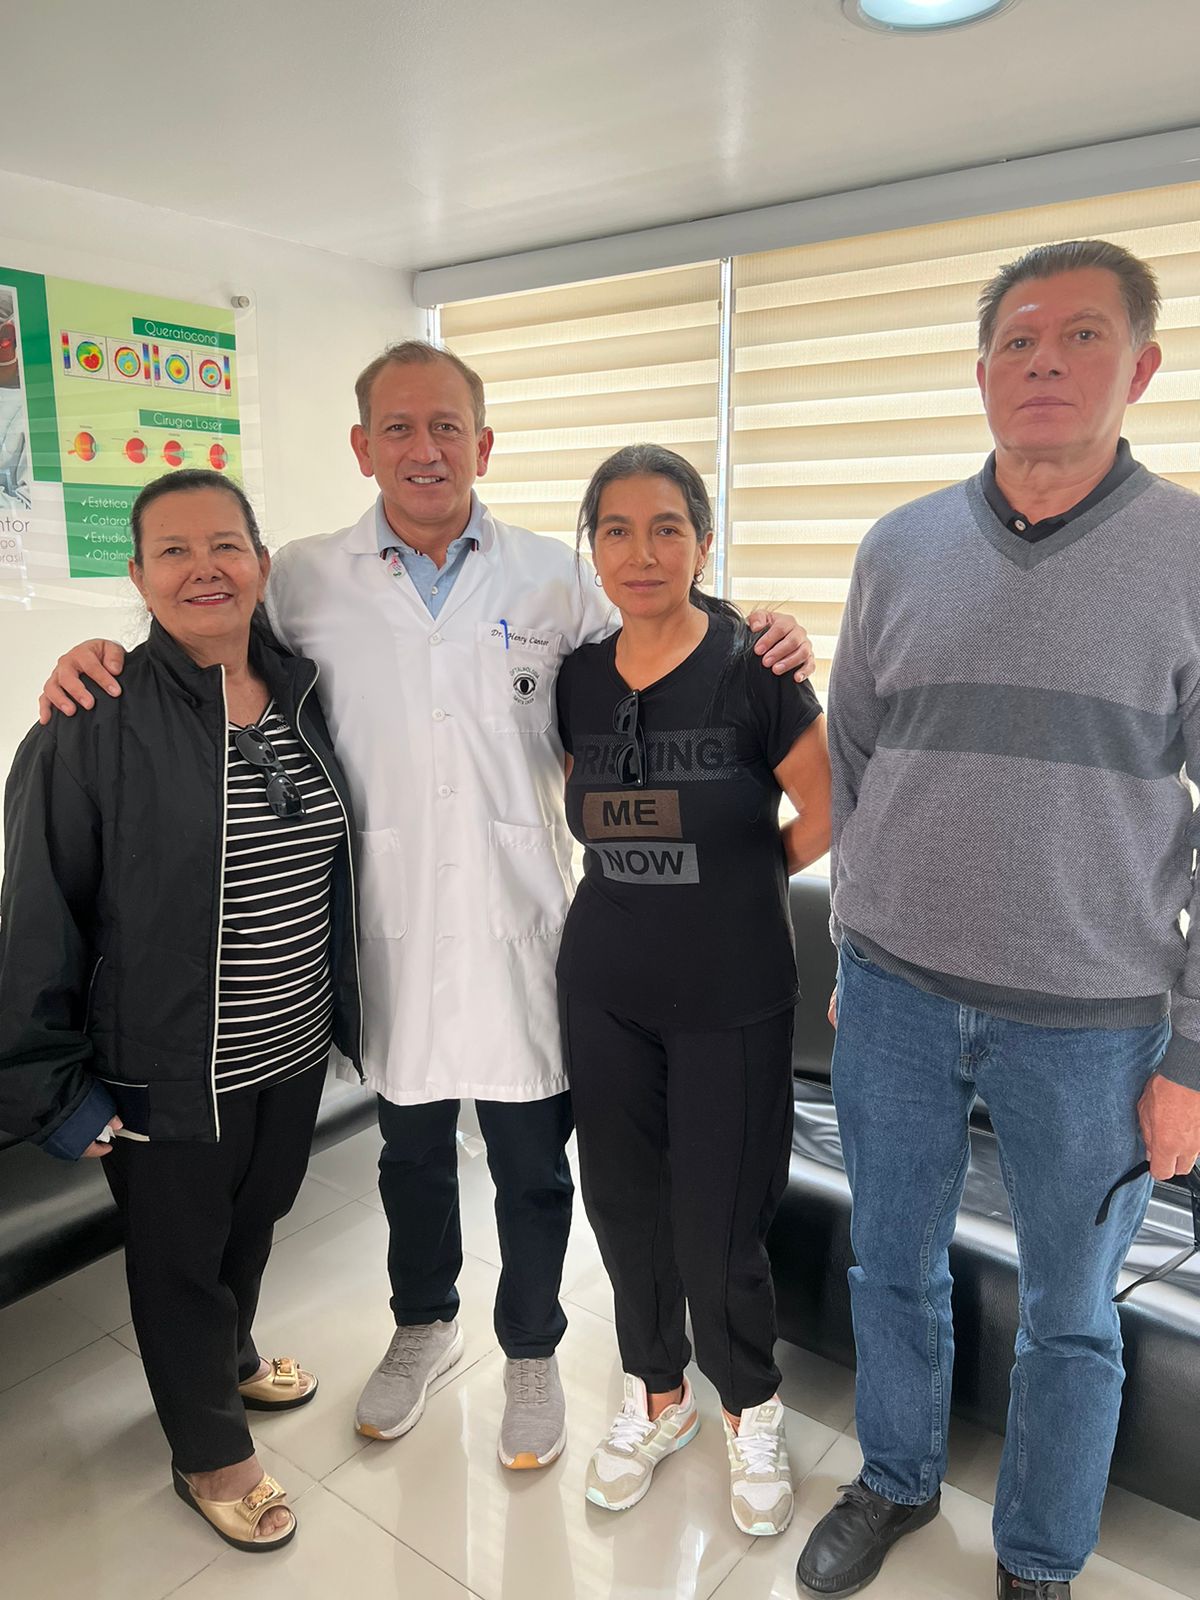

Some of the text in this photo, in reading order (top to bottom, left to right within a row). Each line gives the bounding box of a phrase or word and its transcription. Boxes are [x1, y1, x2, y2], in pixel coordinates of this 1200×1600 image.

[195, 416, 223, 431] Laser
[90, 513, 131, 526] Catarat
[491, 629, 504, 638] Dr.
[507, 632, 527, 645] Henry
[603, 799, 659, 827] ME
[603, 849, 684, 876] NOW
